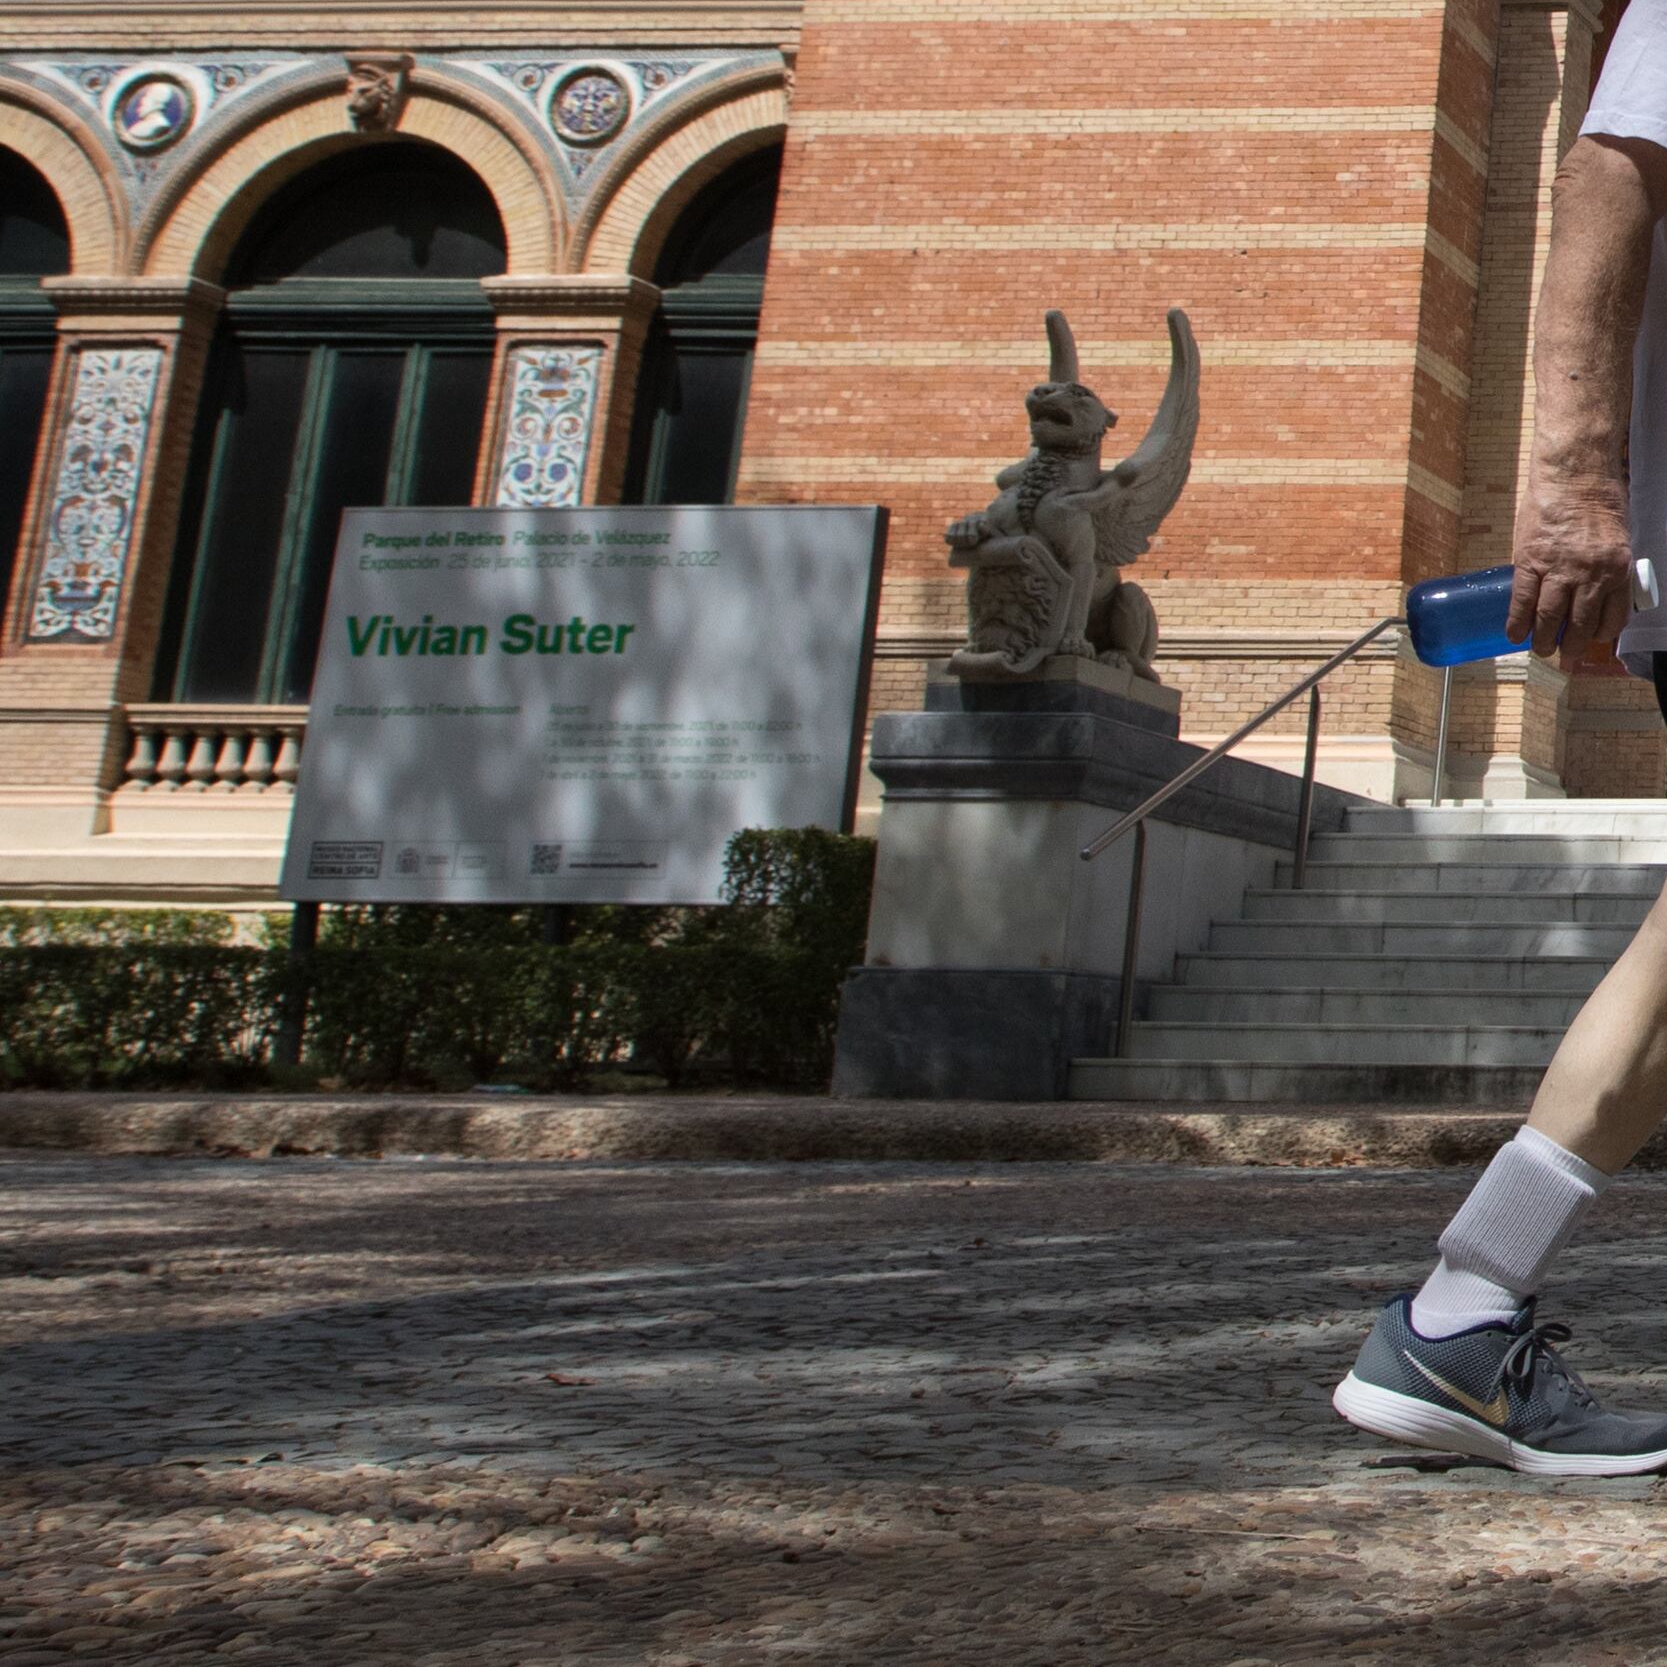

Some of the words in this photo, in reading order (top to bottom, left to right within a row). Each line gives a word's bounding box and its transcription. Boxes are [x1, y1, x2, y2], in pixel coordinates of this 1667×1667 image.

[363, 533, 421, 551] Parque
[425, 532, 451, 547] del
[454, 531, 506, 547] Retiro
[513, 531, 567, 546] Palacio
[571, 531, 590, 546] de
[359, 555, 440, 572] Exposición
[677, 551, 720, 567] 2022
[346, 615, 488, 657] Vivian
[500, 613, 635, 655] Suter
